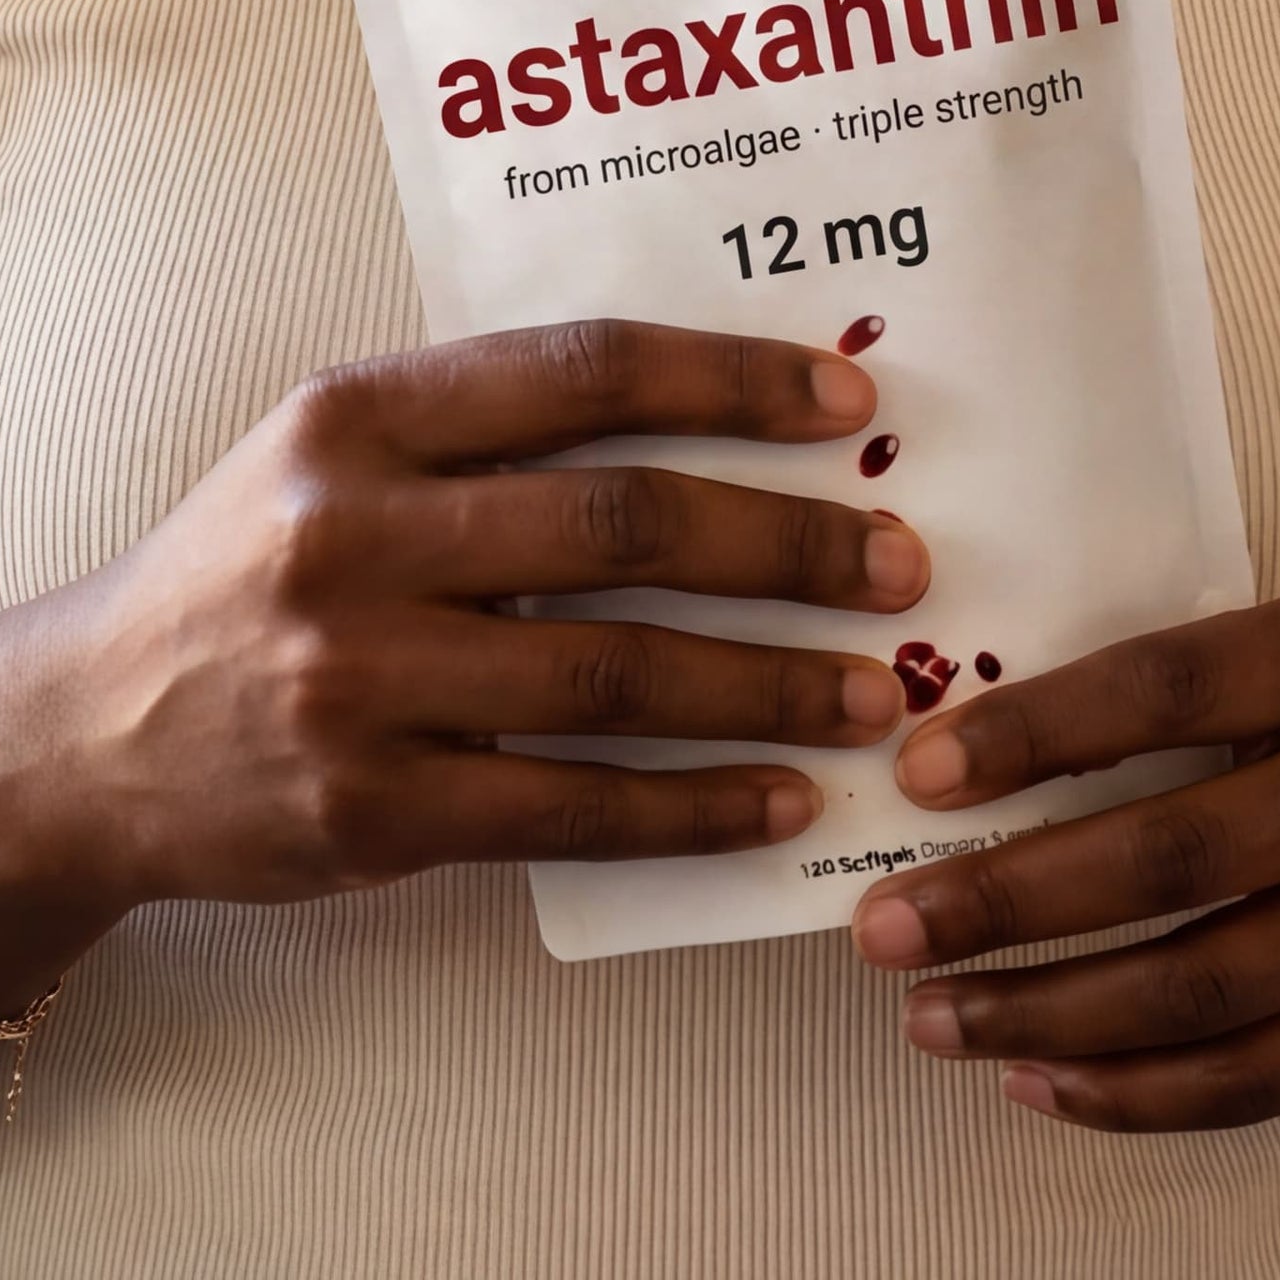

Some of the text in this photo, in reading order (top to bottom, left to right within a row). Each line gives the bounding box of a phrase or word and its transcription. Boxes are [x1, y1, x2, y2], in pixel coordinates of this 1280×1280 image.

[504, 164, 590, 200] from
[600, 126, 802, 184] microalgae
[831, 97, 926, 144] triple
[935, 68, 1084, 125] strength
[722, 205, 930, 281] 12 mg
[800, 859, 836, 879] 120
